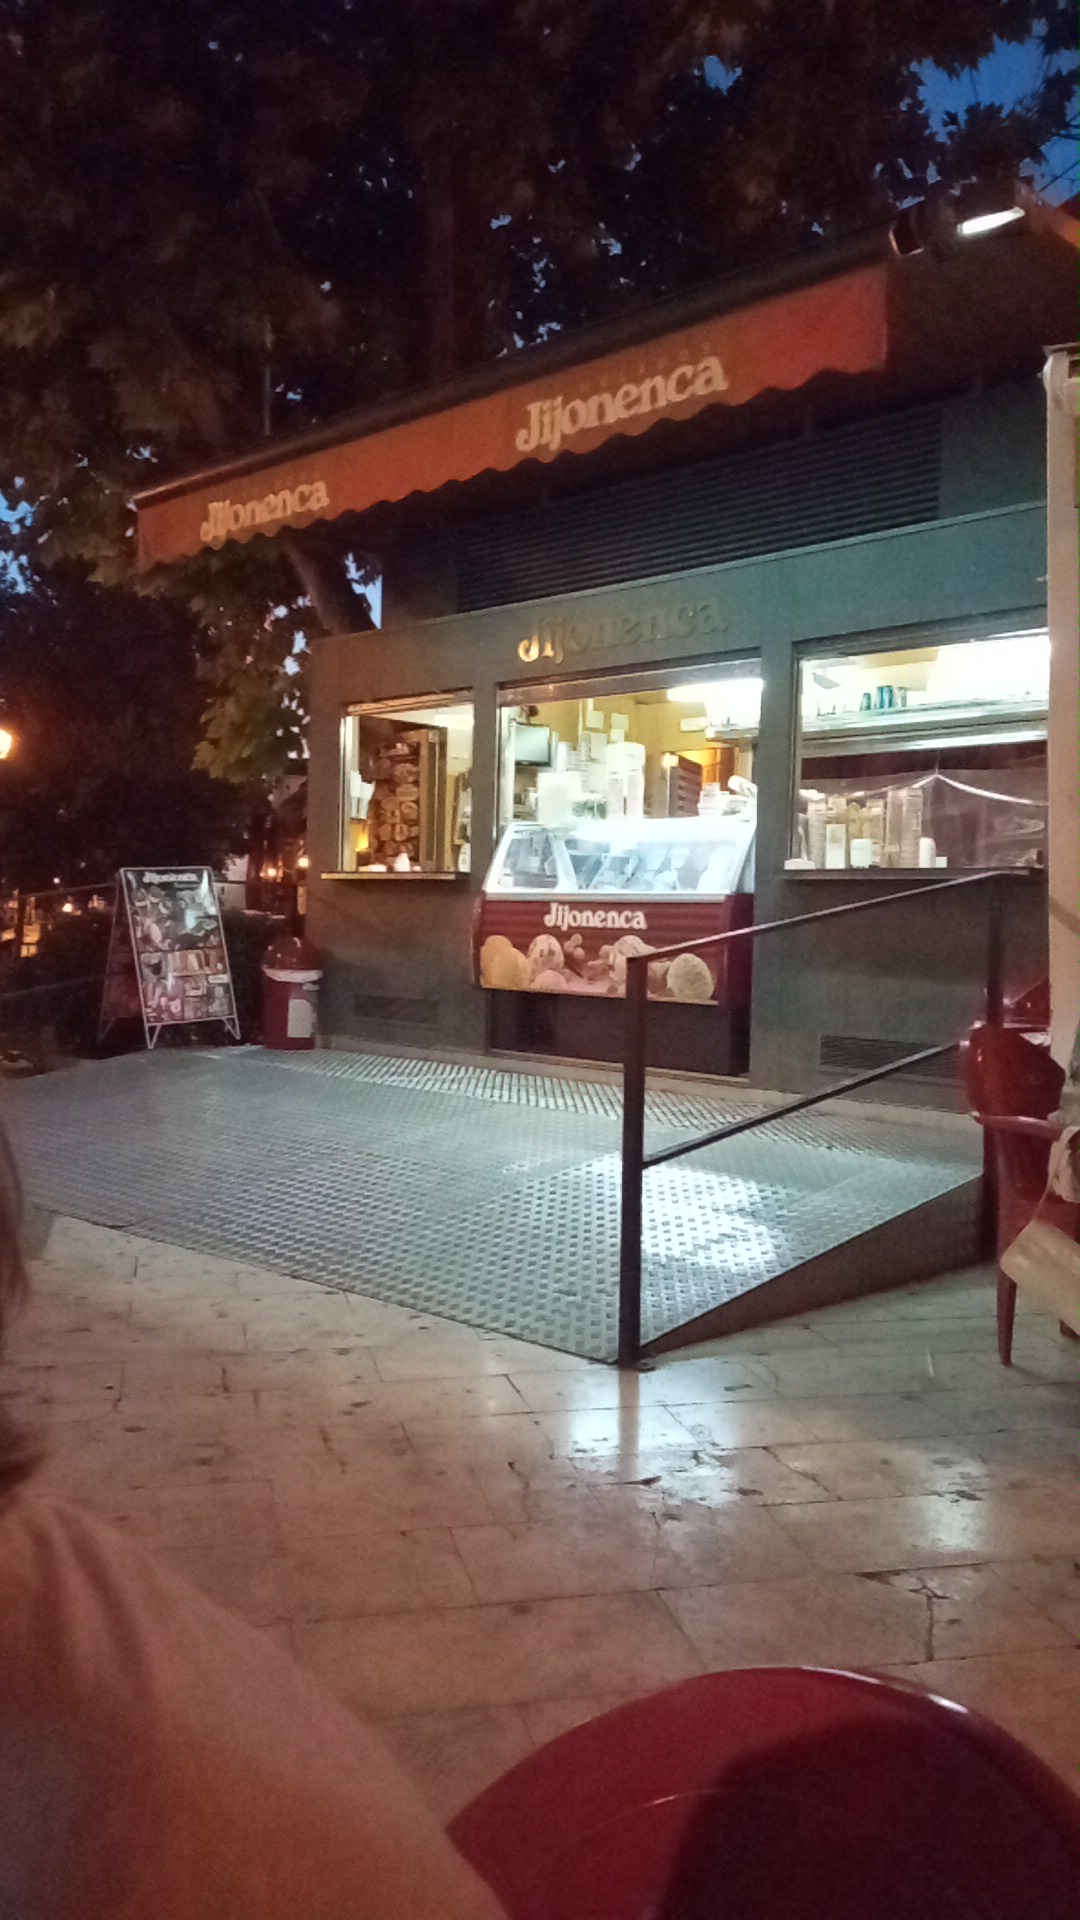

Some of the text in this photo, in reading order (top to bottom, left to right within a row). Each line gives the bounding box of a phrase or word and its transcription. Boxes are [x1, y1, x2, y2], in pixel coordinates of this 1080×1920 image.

[515, 356, 729, 457] Jijonenca
[200, 481, 331, 549] Jijonenca
[543, 902, 648, 932] Jijonenca
